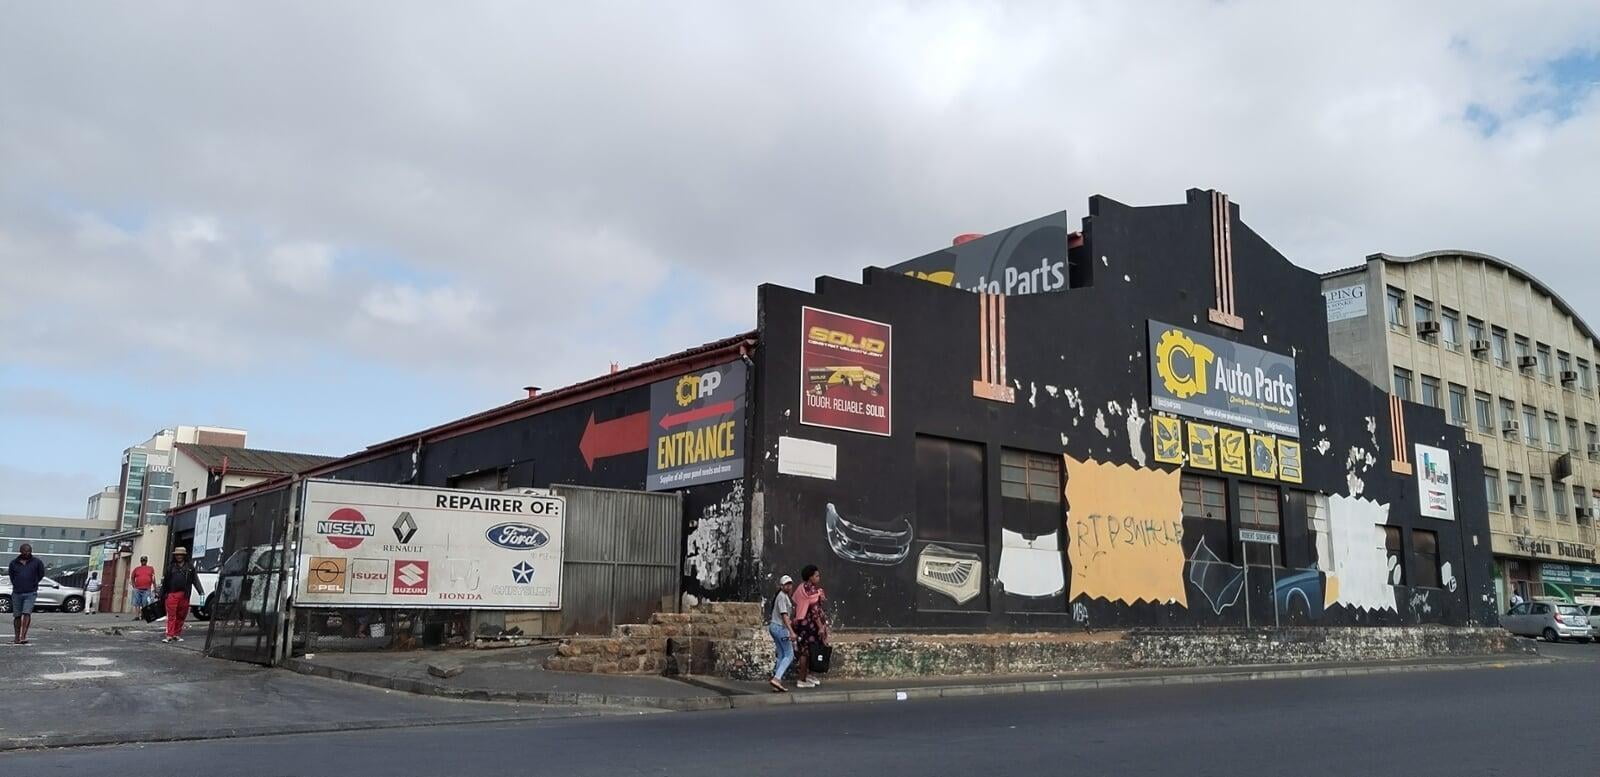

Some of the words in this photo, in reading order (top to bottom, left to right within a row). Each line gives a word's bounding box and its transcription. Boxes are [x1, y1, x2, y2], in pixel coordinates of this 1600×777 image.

[1005, 257, 1065, 296] Parts
[808, 326, 886, 353] SOLID
[1156, 329, 1215, 399] CT
[1215, 356, 1252, 398] Auto
[1255, 366, 1294, 408] Parts
[833, 398, 865, 415] RELIABLE.
[865, 403, 886, 418] SOLID.
[657, 420, 735, 470] ENTRANCE
[436, 494, 523, 513] REPAIRER
[530, 501, 559, 515] OF:
[318, 522, 375, 536] NISSAN
[498, 525, 540, 545] Ford
[383, 544, 424, 553] RENAULT
[1557, 541, 1597, 563] Building
[352, 572, 387, 580] ISUZU
[438, 592, 483, 600] HONDA
